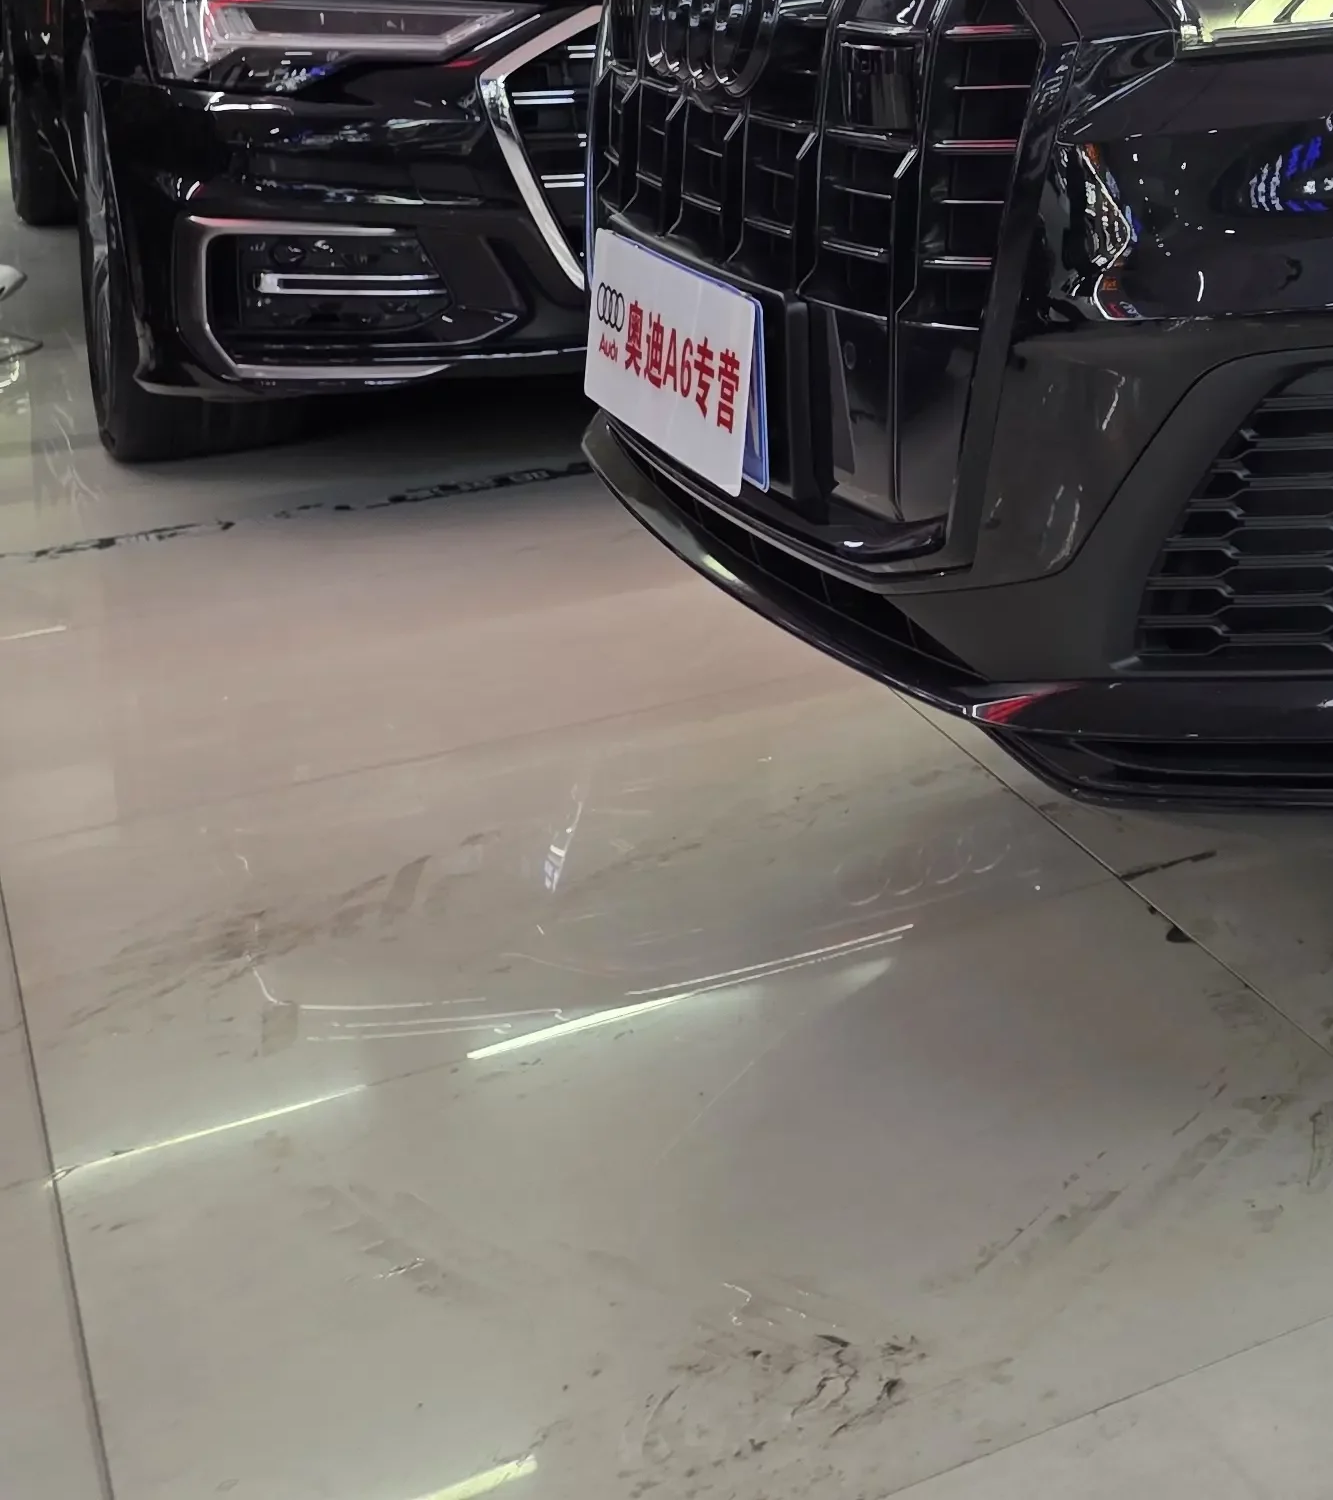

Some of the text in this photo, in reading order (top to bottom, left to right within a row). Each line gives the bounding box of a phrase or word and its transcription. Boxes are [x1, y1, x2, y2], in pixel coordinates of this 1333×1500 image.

[599, 332, 619, 364] Audi
[624, 299, 741, 435] 奥迪A6专营
